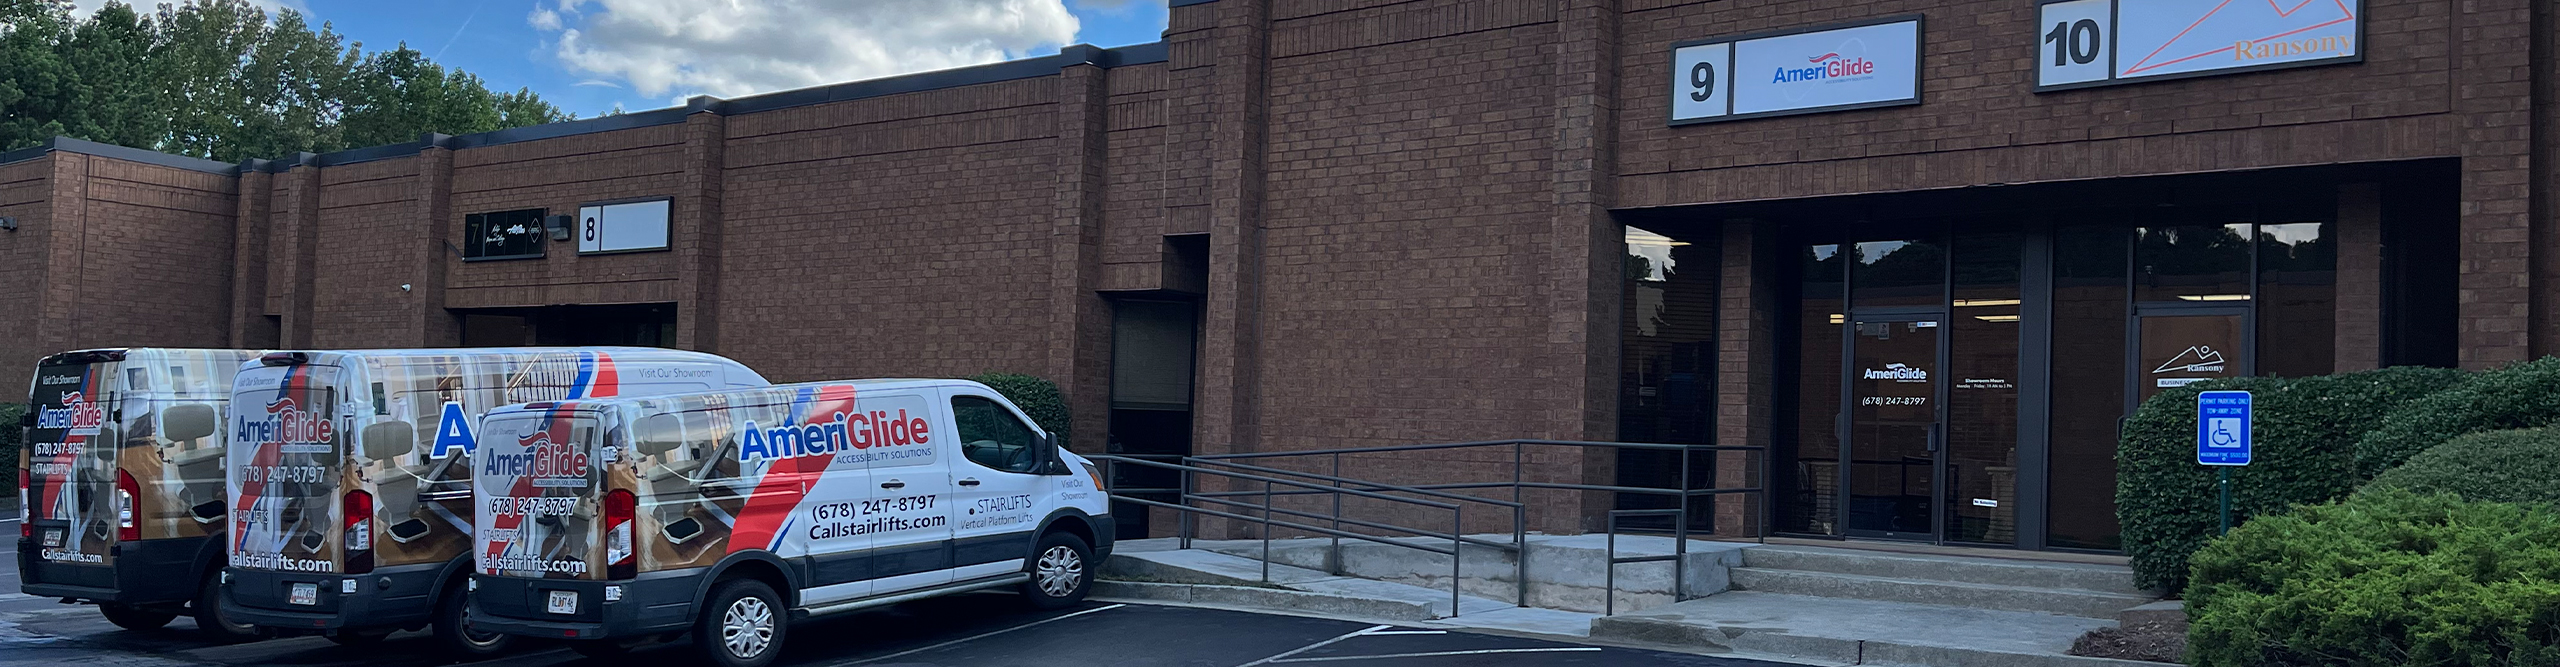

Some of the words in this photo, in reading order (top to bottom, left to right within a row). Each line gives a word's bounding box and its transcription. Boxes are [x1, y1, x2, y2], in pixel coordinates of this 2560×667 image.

[2045, 18, 2100, 68] 10
[2234, 34, 2353, 61] Ransony
[1772, 57, 1873, 84] AmeriGlide
[1690, 61, 1715, 102] 9
[471, 223, 480, 244] 7
[586, 217, 595, 241] 8
[639, 368, 656, 378] Visit
[657, 368, 672, 378] Our
[674, 367, 713, 378] Showroom
[1863, 367, 1927, 380] AmeriGlide
[2187, 364, 2224, 373] Ransony
[51, 375, 59, 385] Our
[59, 374, 80, 385] Showroom
[253, 376, 275, 386] Showroom
[1862, 397, 1883, 406] (678)
[1886, 397, 1926, 405] 247-8797
[38, 402, 102, 429] AmeriGlide
[237, 410, 332, 443] AmeriGlide
[740, 408, 930, 461] AmeriGlide
[35, 442, 52, 457] (678)
[53, 442, 84, 455] 247-8797
[836, 452, 889, 465] ACCESSIBILITY
[891, 448, 932, 459] SOLUTIONS
[35, 463, 68, 475] STAIRLIFTS
[485, 444, 587, 477] AmeriGlide
[241, 465, 263, 485] (678)
[267, 466, 326, 484] 247-8797
[1061, 479, 1073, 488] Visit
[1073, 480, 1084, 488] Our
[978, 494, 1032, 514] STAIRLIFTS
[1061, 492, 1088, 501] Showroom
[232, 508, 268, 524] STAIRLIFTS
[488, 497, 514, 517] (678)
[517, 497, 577, 515] 247-8797
[812, 502, 856, 523] (678)
[862, 494, 937, 515] 247-8797
[809, 515, 946, 540] Callstairlifts.com
[960, 516, 987, 530] Vertical
[988, 515, 1017, 527] Platform
[1018, 512, 1034, 524] Lifts
[482, 529, 518, 542] STAIRLIFTS
[42, 548, 103, 563] Callstairlifts.com
